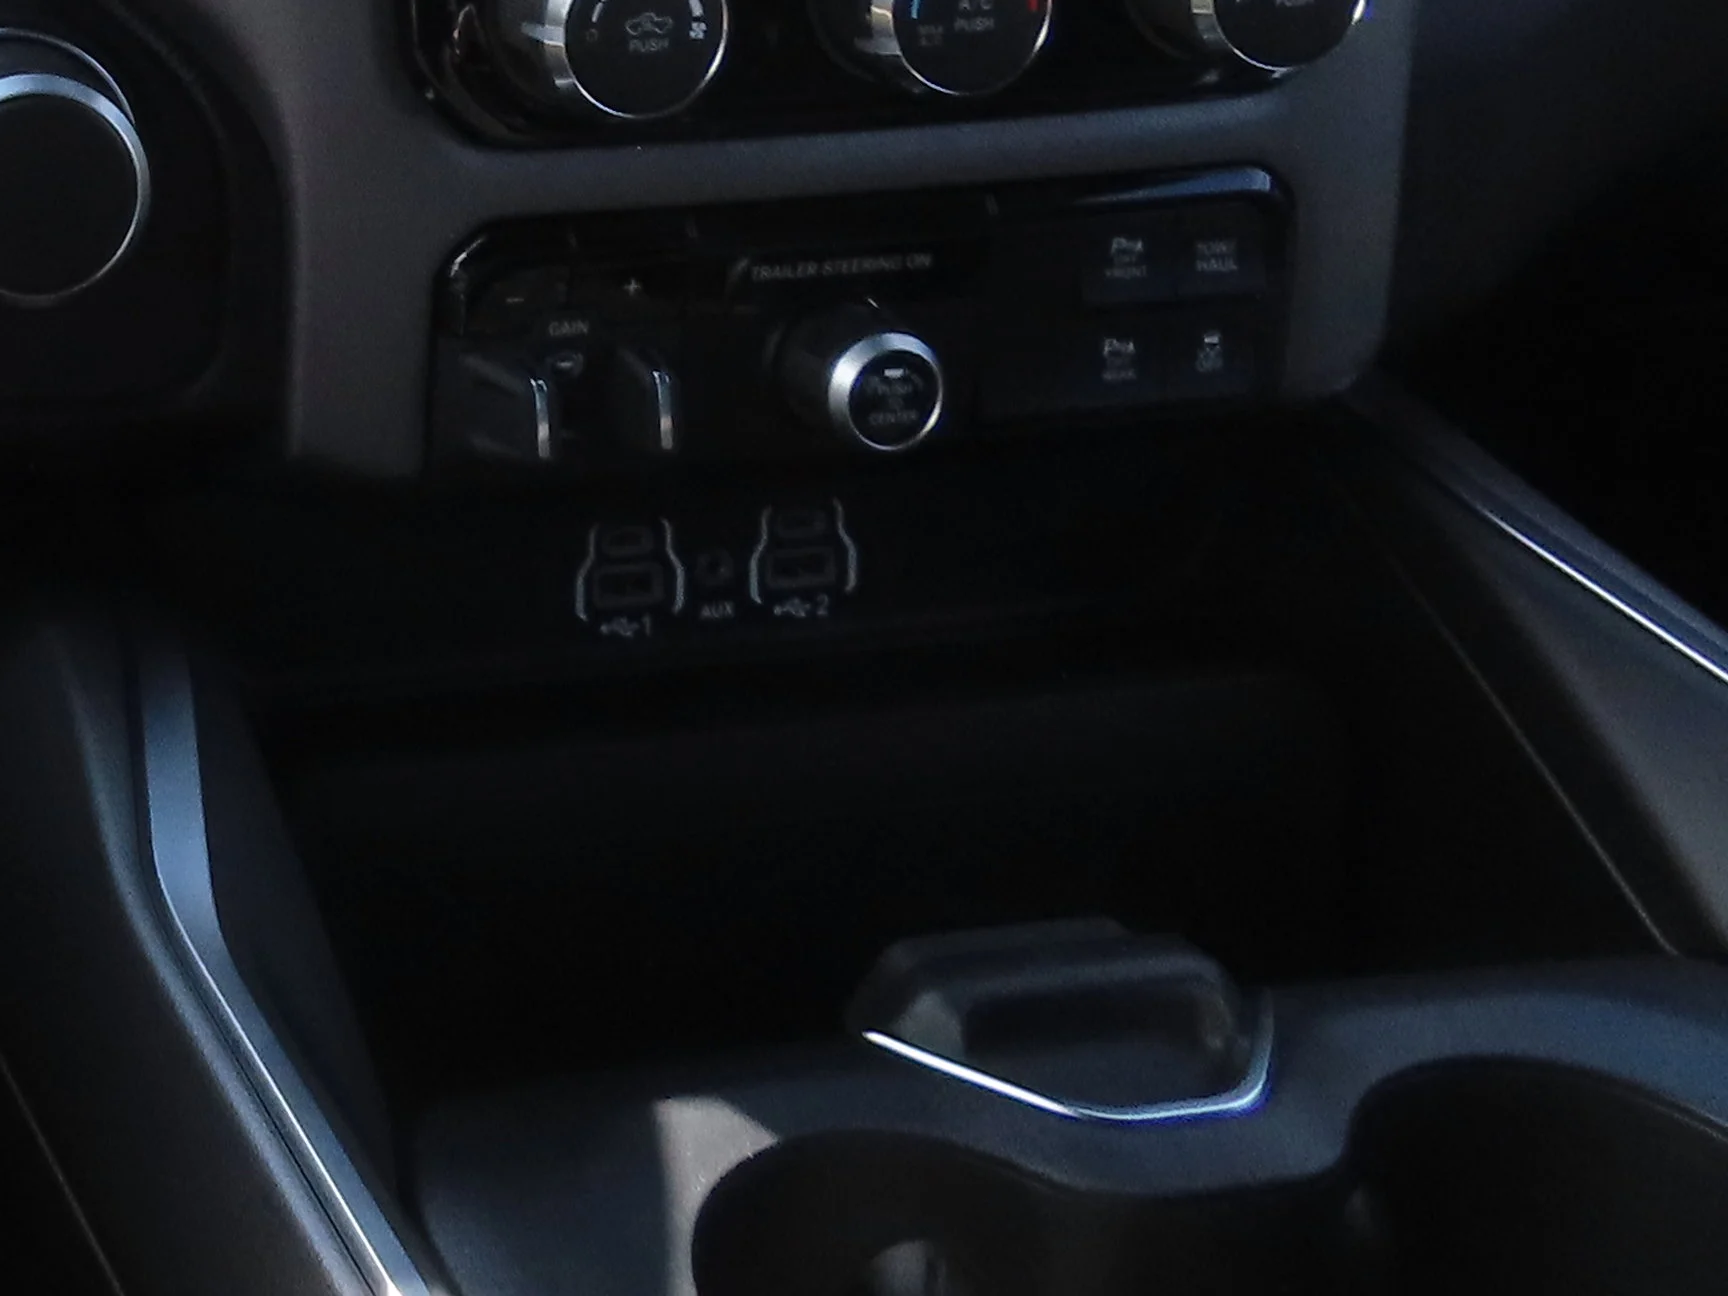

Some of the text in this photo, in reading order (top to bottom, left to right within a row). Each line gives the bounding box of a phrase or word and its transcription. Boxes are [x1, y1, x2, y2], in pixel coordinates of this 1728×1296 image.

[750, 253, 933, 282] TRAILER STEERING ON
[548, 319, 590, 337] GAIN
[697, 599, 737, 620] AUX
[815, 592, 831, 617] 2
